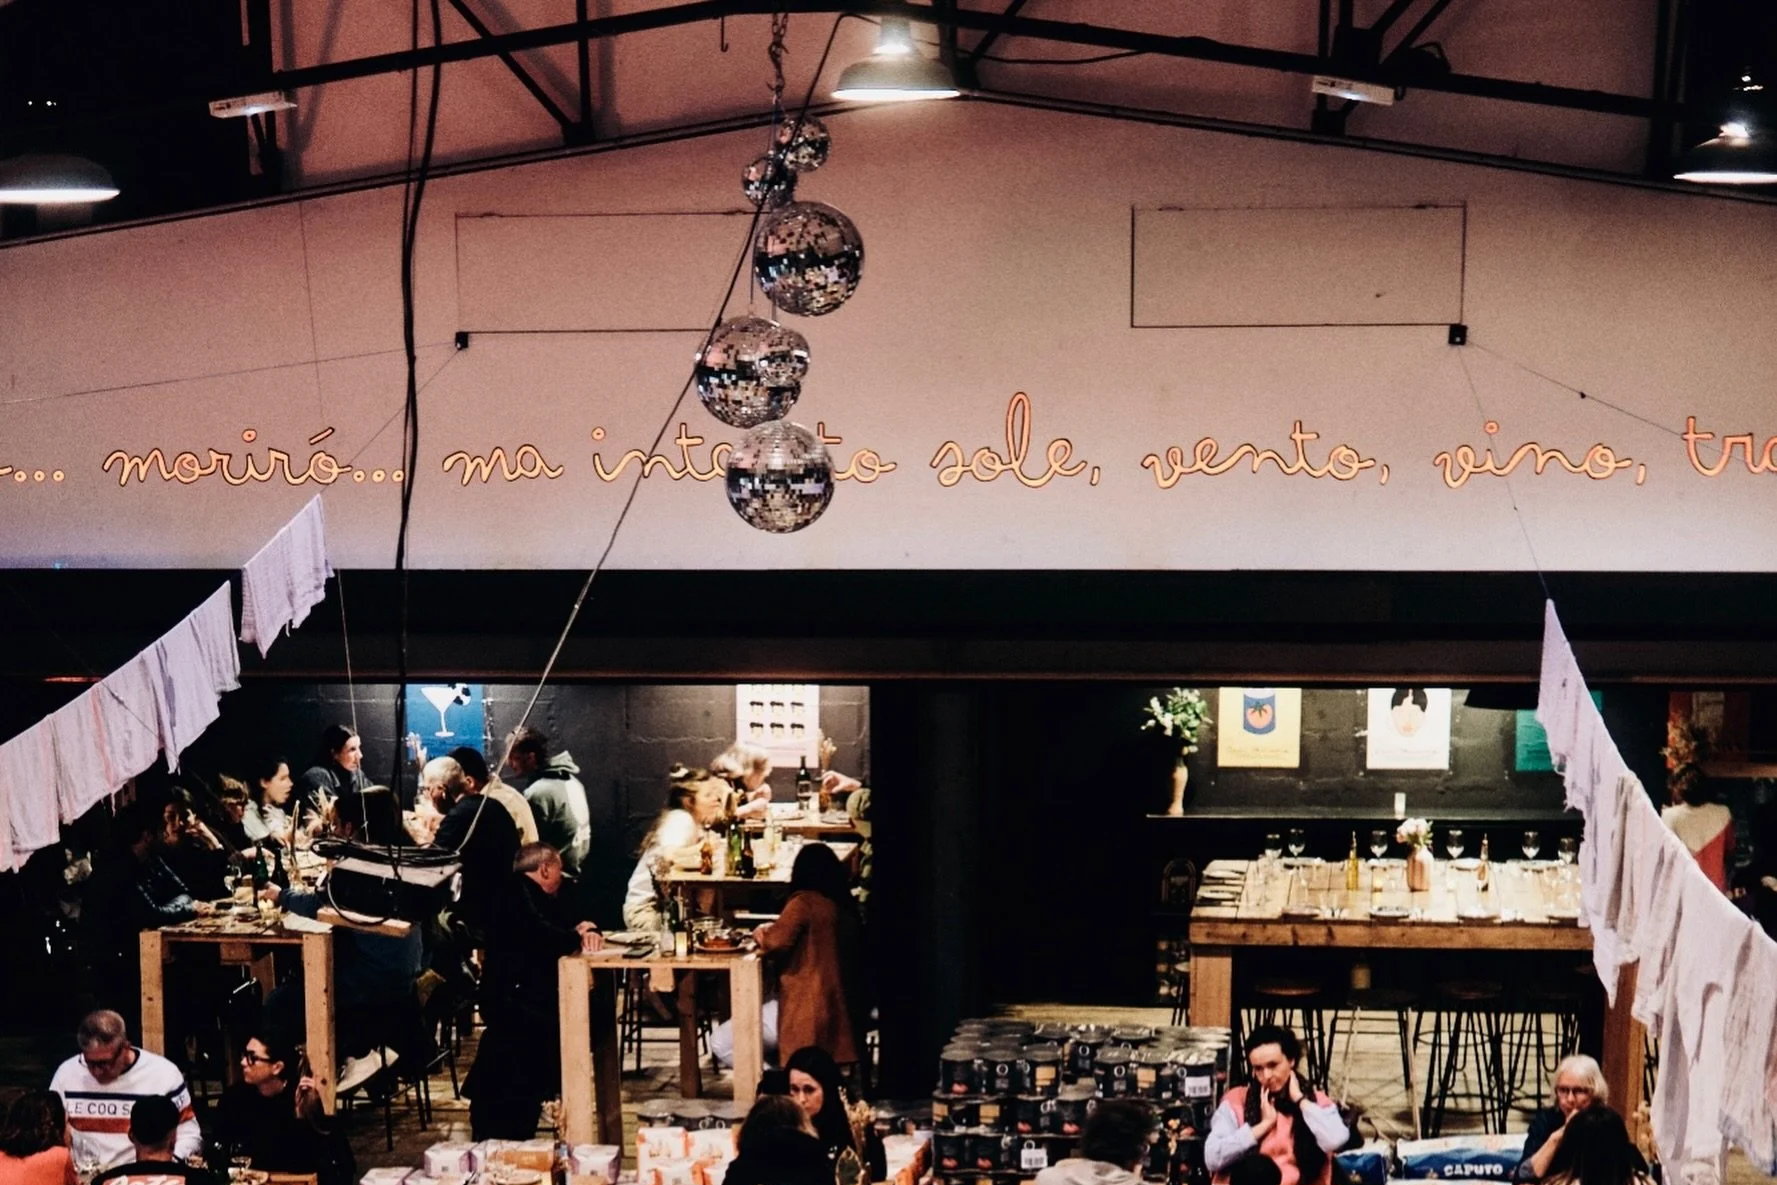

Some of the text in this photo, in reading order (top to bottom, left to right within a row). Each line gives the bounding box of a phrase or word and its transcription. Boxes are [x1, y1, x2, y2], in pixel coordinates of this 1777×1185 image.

[443, 443, 564, 486] ma
[930, 391, 1101, 489] sole,
[1140, 419, 1391, 489] vento,
[1433, 419, 1647, 489] vino,
[87, 1102, 118, 1116] COQ
[1443, 1163, 1504, 1177] CAPUTO
